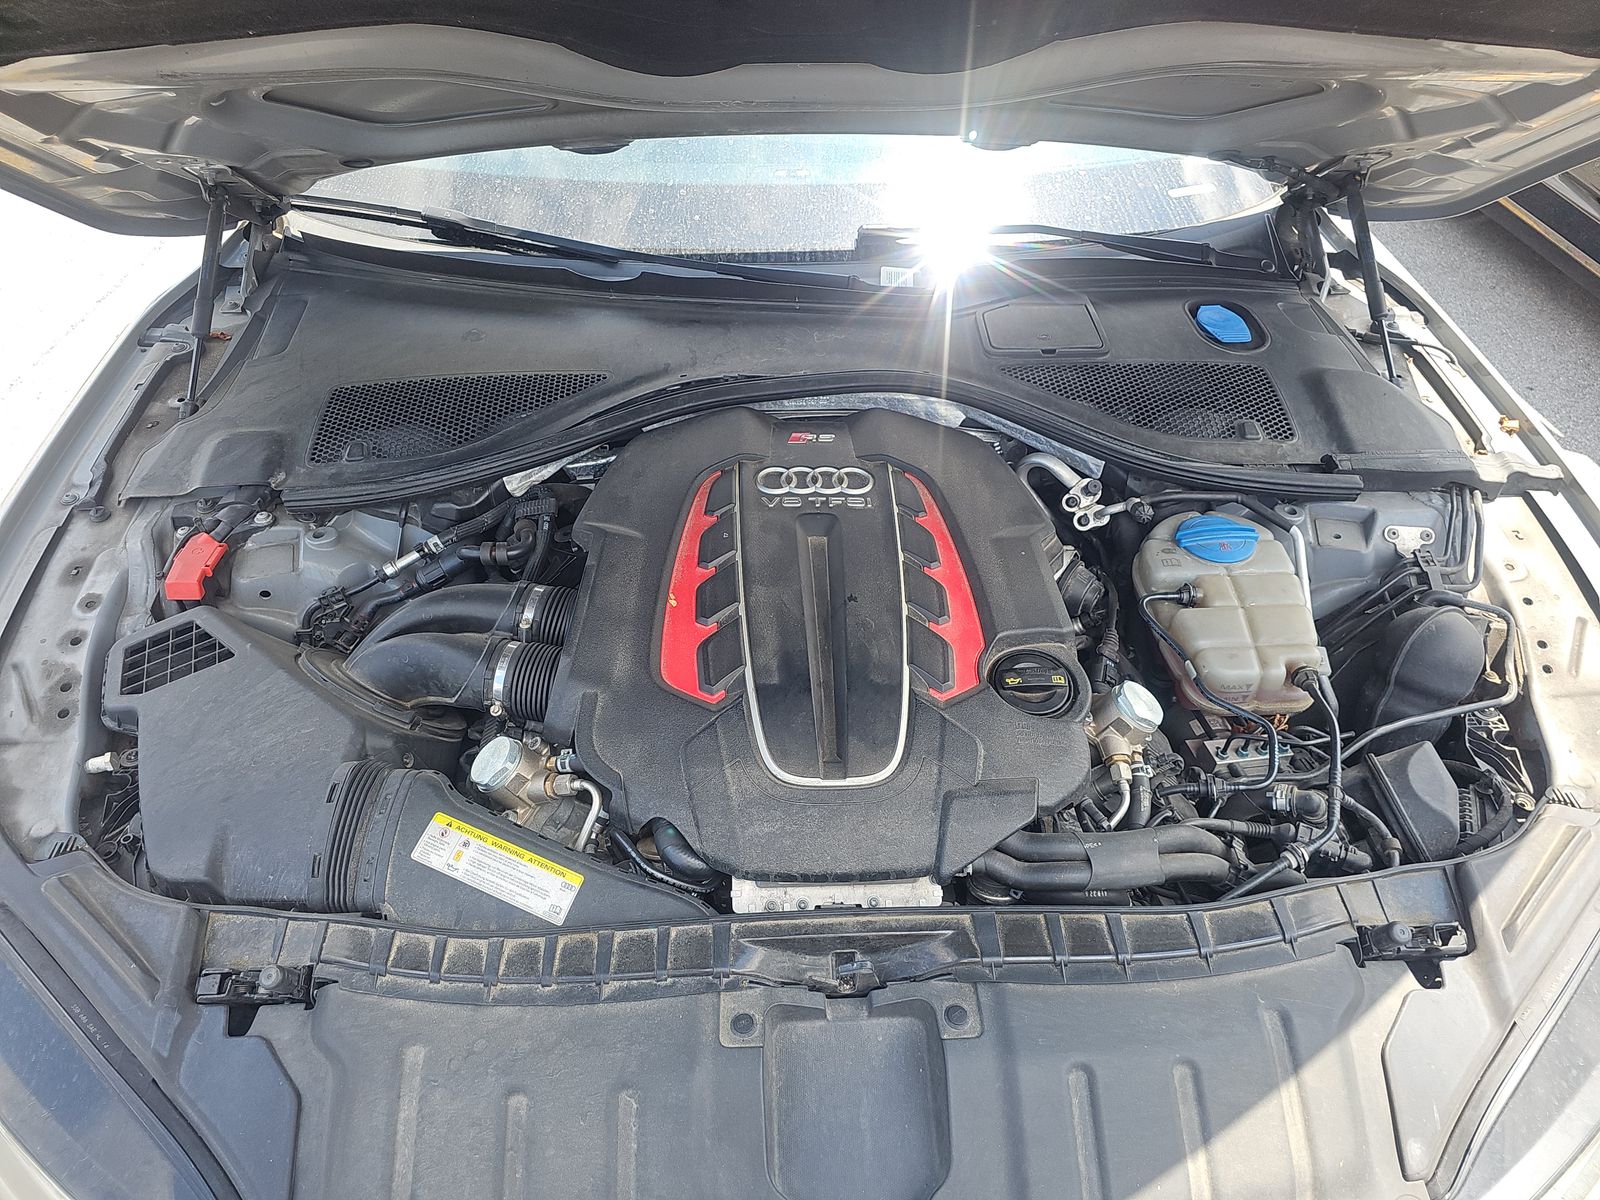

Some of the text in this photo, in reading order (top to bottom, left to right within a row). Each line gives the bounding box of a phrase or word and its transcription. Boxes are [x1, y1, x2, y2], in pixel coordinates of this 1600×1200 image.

[761, 496, 874, 508] V8 TFSI
[455, 825, 488, 844] ACHTUNG
[491, 840, 525, 860] WARNING
[527, 857, 567, 879] ATTENTION
